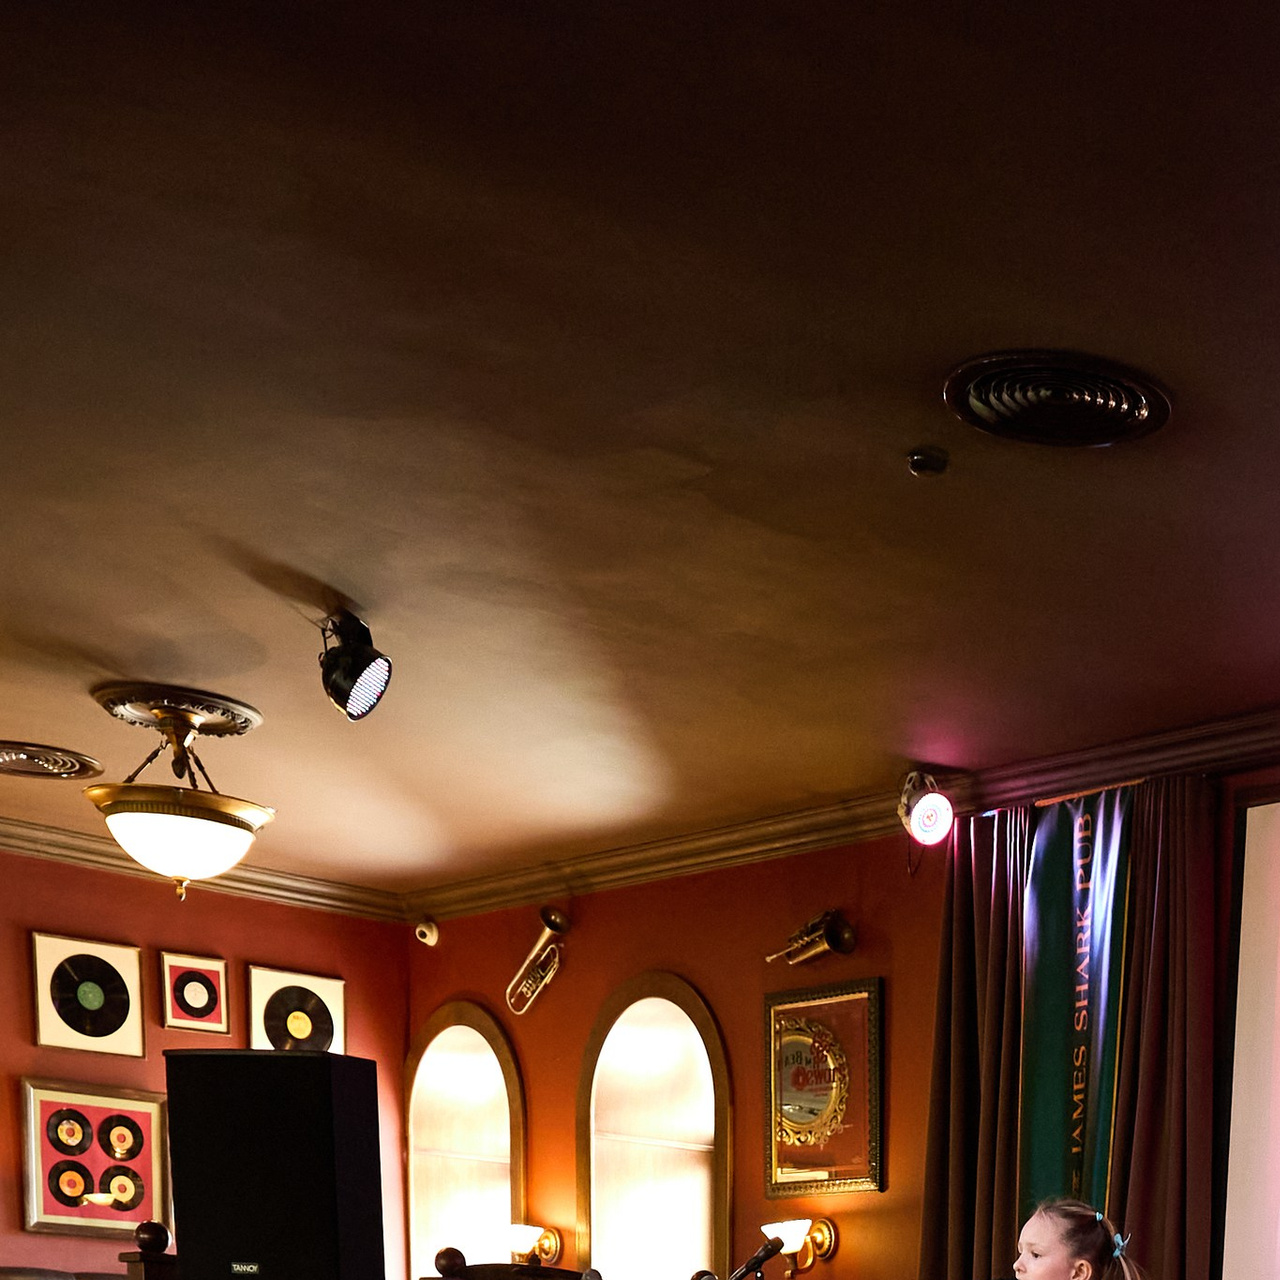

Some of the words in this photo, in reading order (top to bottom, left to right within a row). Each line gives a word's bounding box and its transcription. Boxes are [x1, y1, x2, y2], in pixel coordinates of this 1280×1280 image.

[1076, 813, 1093, 891] PUB
[1073, 903, 1092, 1031] SHARK
[231, 1263, 259, 1273] TANNOY
